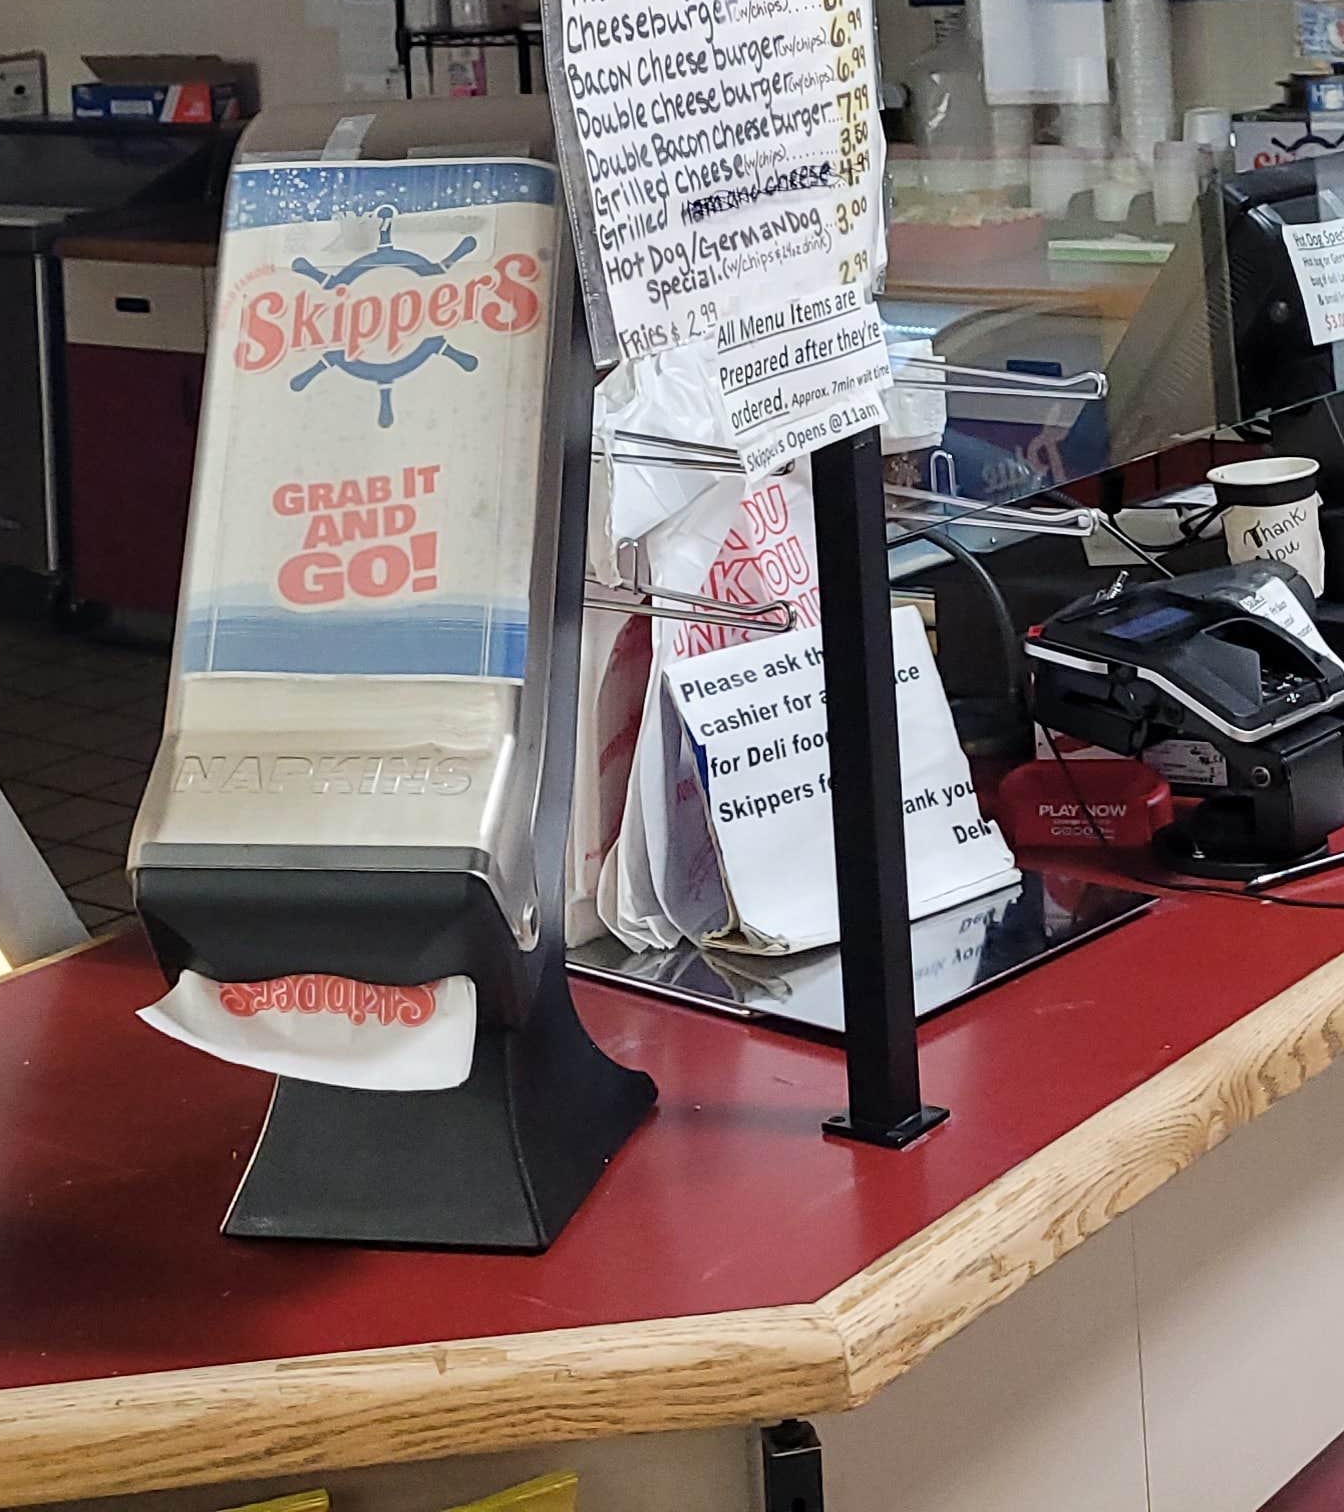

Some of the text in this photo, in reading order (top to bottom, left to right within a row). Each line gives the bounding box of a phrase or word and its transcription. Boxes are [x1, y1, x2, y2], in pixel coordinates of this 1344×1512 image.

[829, 8, 863, 48] 6.99
[576, 101, 648, 141] Double
[836, 44, 866, 83] 6.99
[586, 141, 653, 183] Double
[651, 129, 711, 167] Bacon
[837, 85, 869, 124] 7.99
[594, 170, 670, 221] Grilled
[599, 208, 668, 253] Grilled
[606, 251, 644, 285] Hot
[836, 195, 868, 235] 3.00
[839, 250, 869, 286] 2.99
[717, 288, 856, 349] All Menu Items are
[719, 319, 880, 390] Prepared after they're
[730, 363, 890, 431] ordered. Approx. 7min wait time
[745, 402, 880, 472] Skippers Opens @11am
[272, 464, 441, 517] GRAB IT
[302, 503, 417, 551] AND
[1242, 506, 1307, 548] Thank
[277, 530, 438, 605] GO!
[680, 647, 826, 705] Please ask th
[699, 694, 814, 738] cashier for
[171, 753, 473, 797] NAPKINS
[710, 739, 787, 780] for Deli
[718, 778, 814, 824] Skippers
[1038, 804, 1079, 817] PLAY
